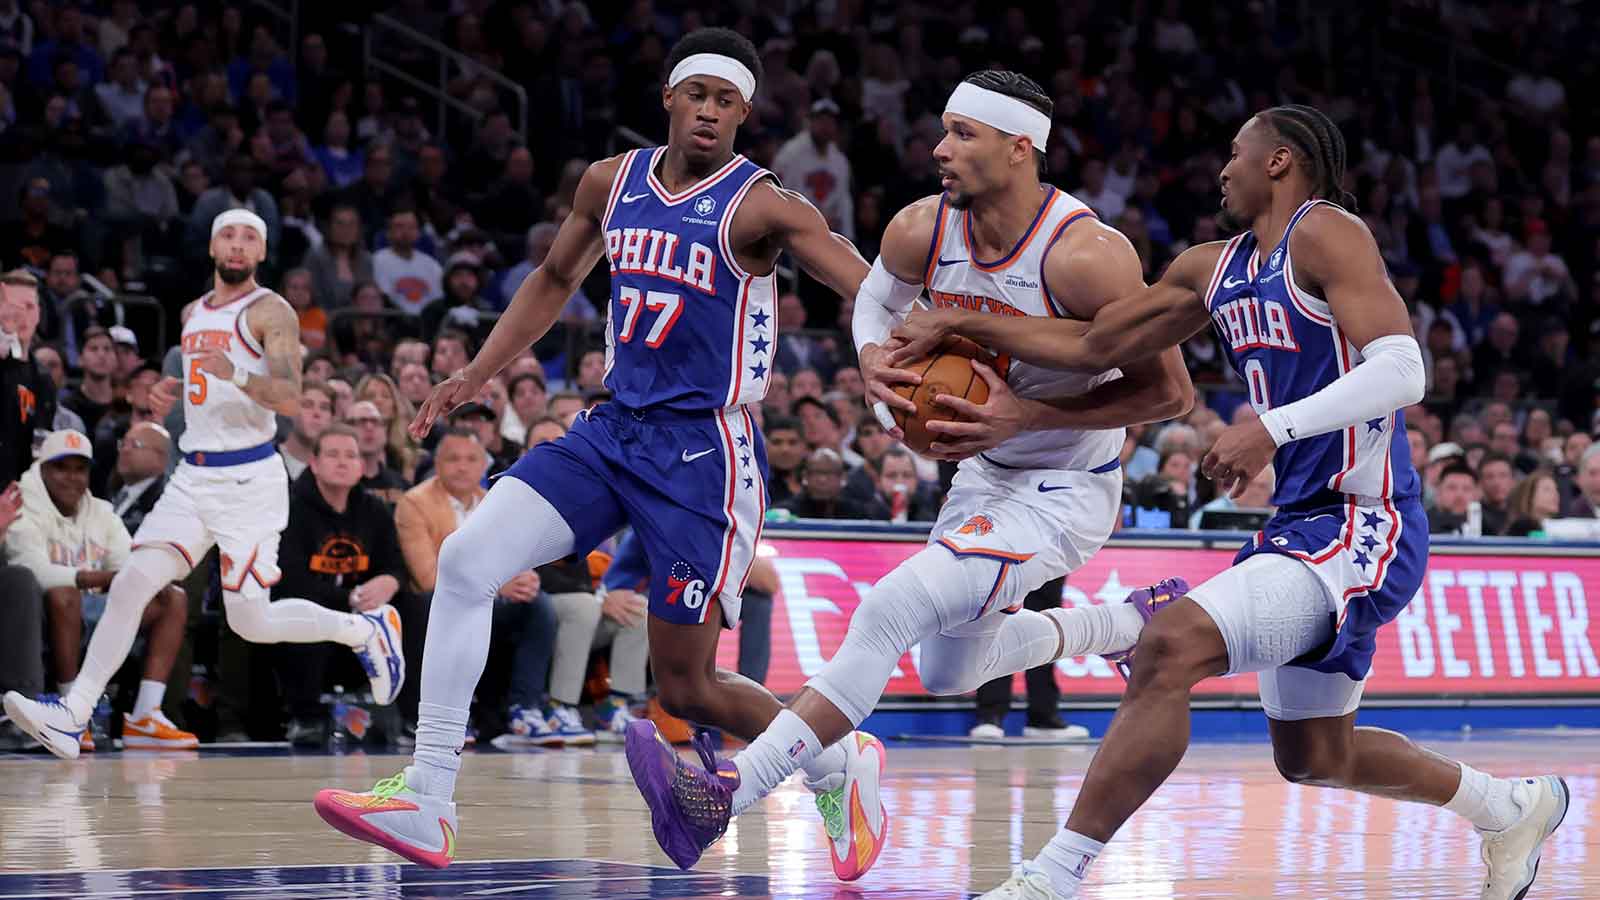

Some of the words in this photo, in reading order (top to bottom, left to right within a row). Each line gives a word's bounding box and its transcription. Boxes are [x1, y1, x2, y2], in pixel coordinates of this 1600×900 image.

[606, 228, 717, 296] PHILA
[619, 285, 684, 349] 77
[1211, 297, 1302, 353] PHILA
[189, 359, 208, 405] 5
[665, 576, 705, 609] 76
[1397, 569, 1600, 678] BETTER
